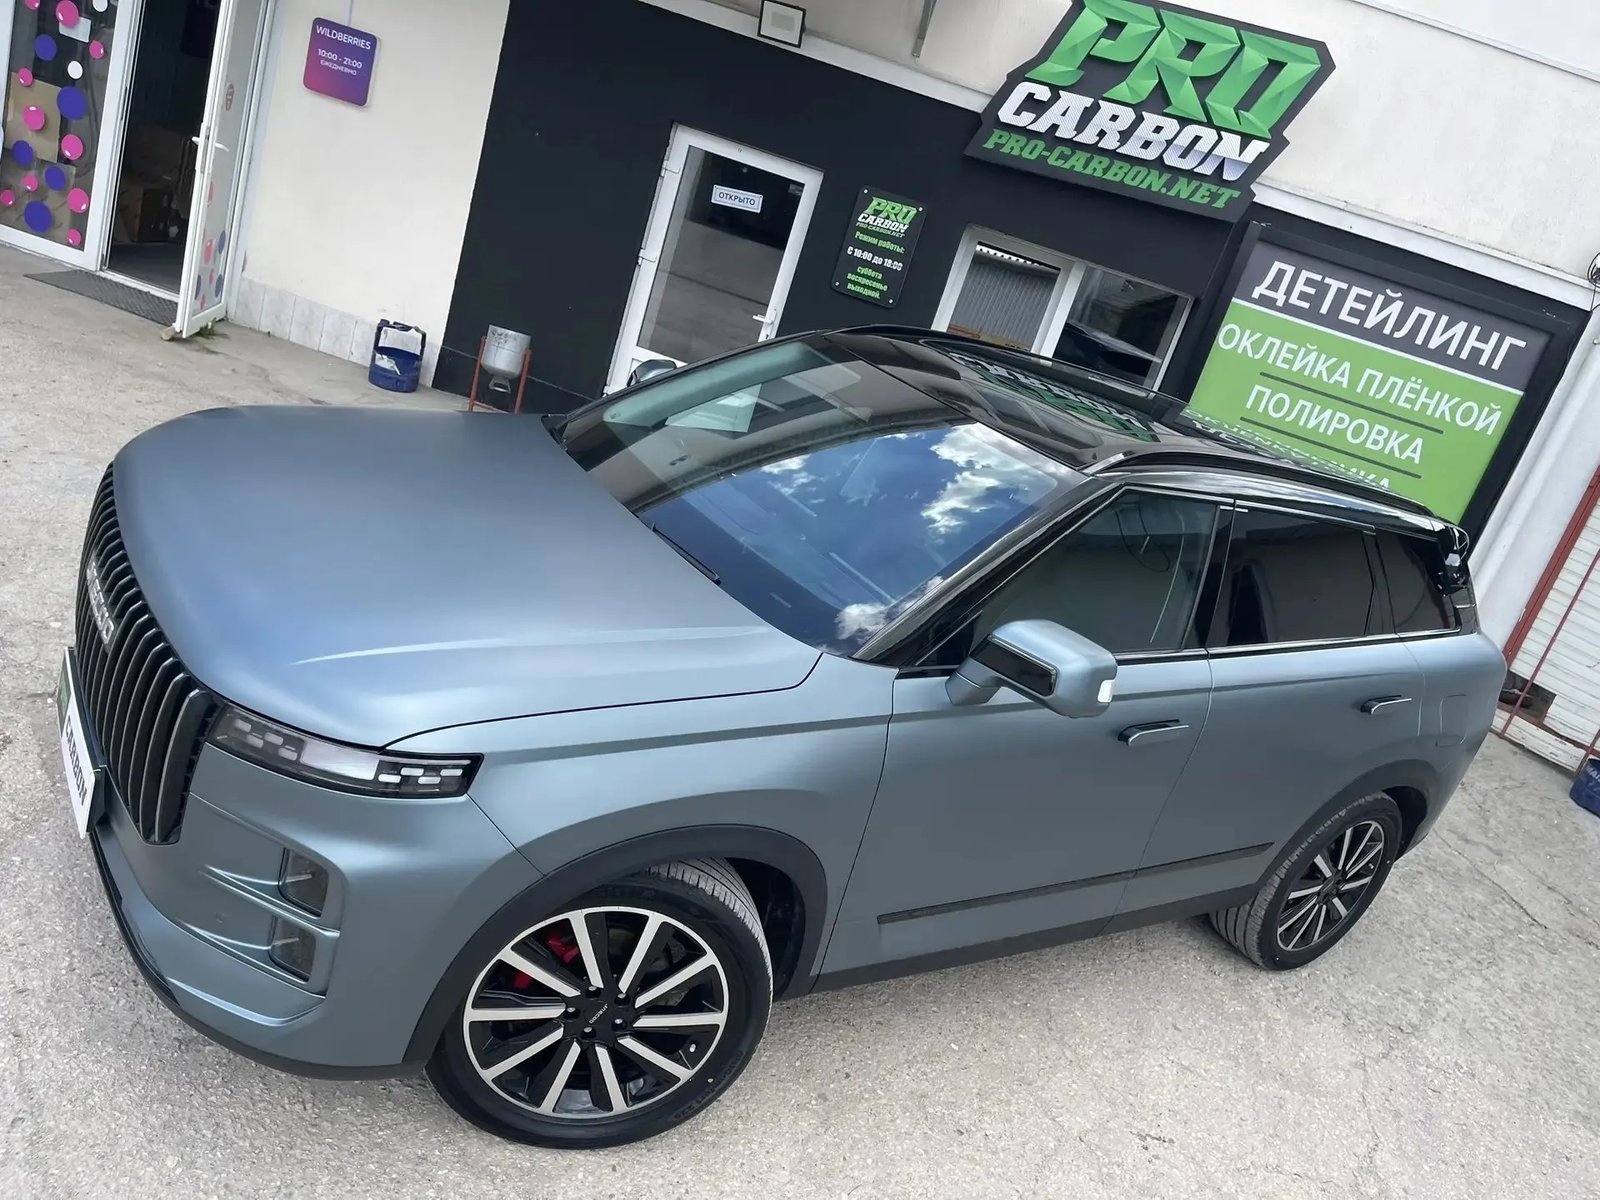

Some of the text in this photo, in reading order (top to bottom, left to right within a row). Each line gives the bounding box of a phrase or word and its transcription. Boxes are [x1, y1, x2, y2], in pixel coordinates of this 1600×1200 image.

[316, 25, 371, 50] WILDBERRIES
[318, 48, 338, 61] 10:00
[343, 56, 362, 69] 21:00
[1024, 0, 1321, 140] PRO
[997, 81, 1270, 182] CARBON
[982, 129, 1241, 209] PRO-CARBON.NET
[718, 191, 756, 206] ОТКРЫТО
[863, 197, 917, 224] PRO
[858, 213, 909, 233] CARBON
[854, 248, 873, 261] 10:00
[884, 259, 903, 271] 18:00
[857, 266, 882, 279] суббота
[1251, 260, 1528, 371] ДЕТЕЙЛИНГ
[1217, 324, 1351, 389] ОКЛЕЙКА
[1355, 368, 1503, 437] ПЛЁНКОЙ
[1245, 384, 1424, 465] ПОЛИРОВКА
